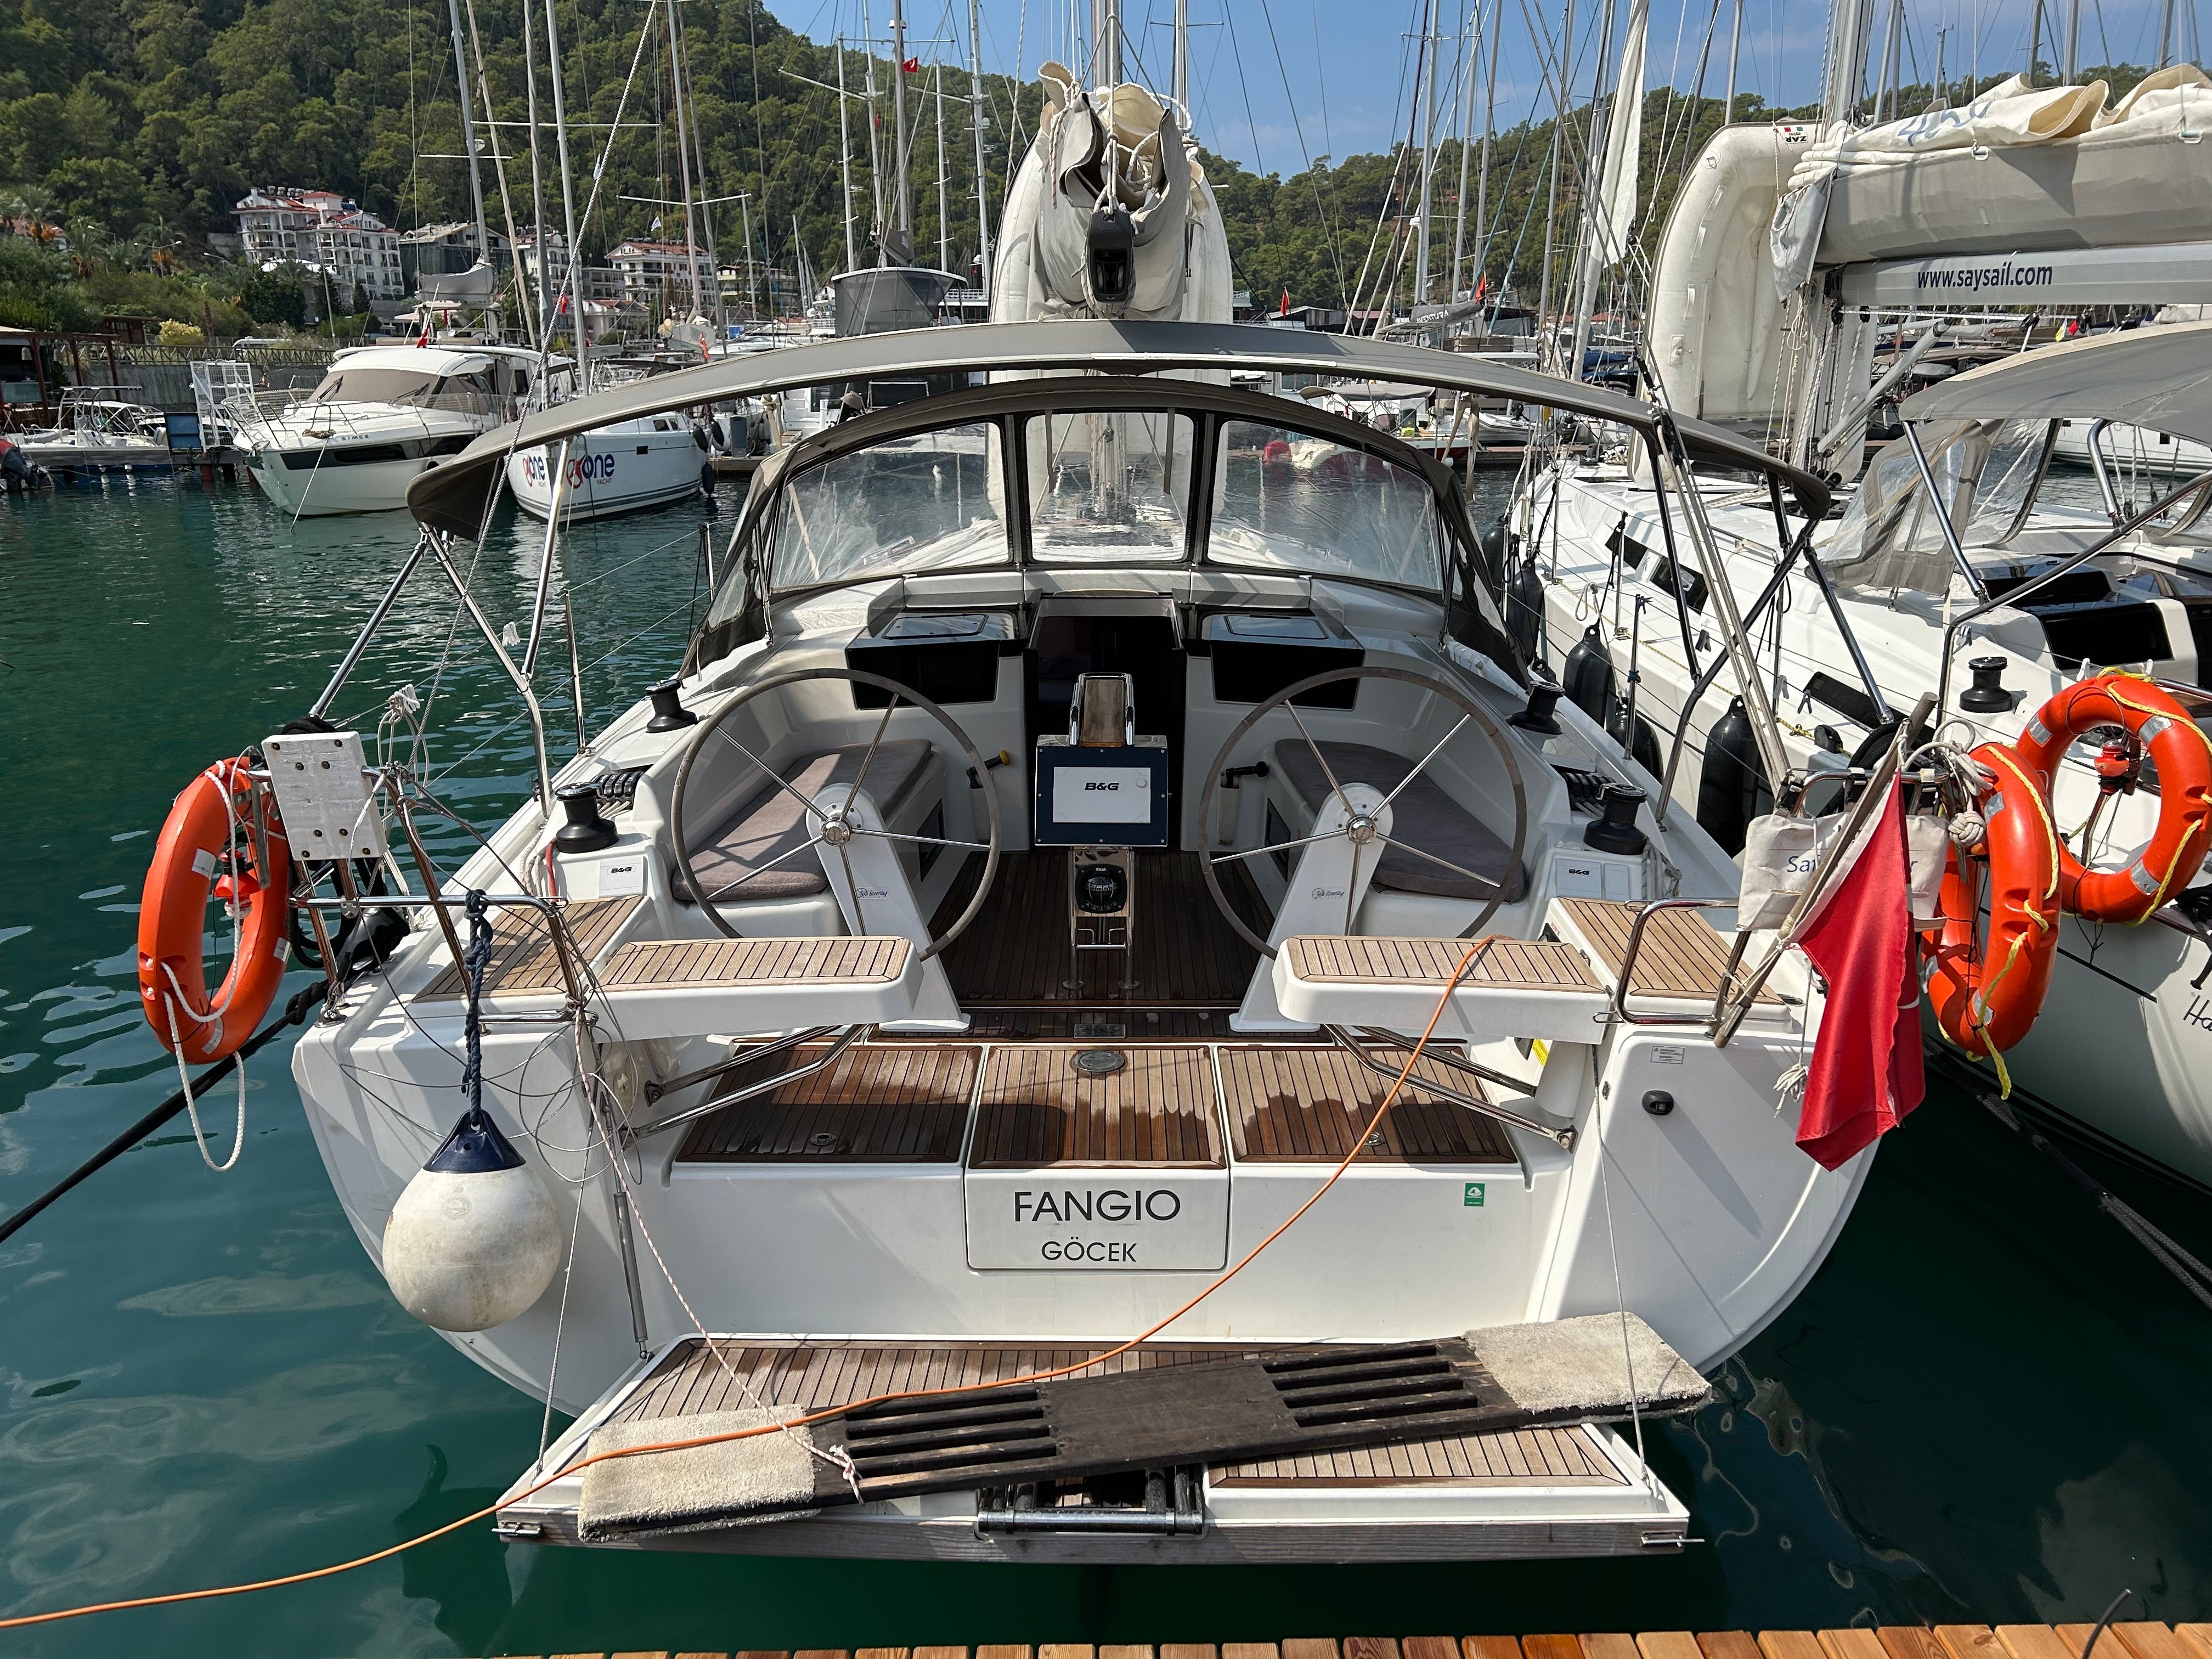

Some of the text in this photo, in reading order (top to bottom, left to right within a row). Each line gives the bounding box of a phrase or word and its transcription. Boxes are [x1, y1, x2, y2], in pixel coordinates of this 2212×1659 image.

[1917, 261, 2053, 291] www.saysail.com
[1085, 782, 1120, 791] B&G
[1014, 1189, 1181, 1222] FANGIO
[1041, 1236, 1137, 1262] GÖCEK
